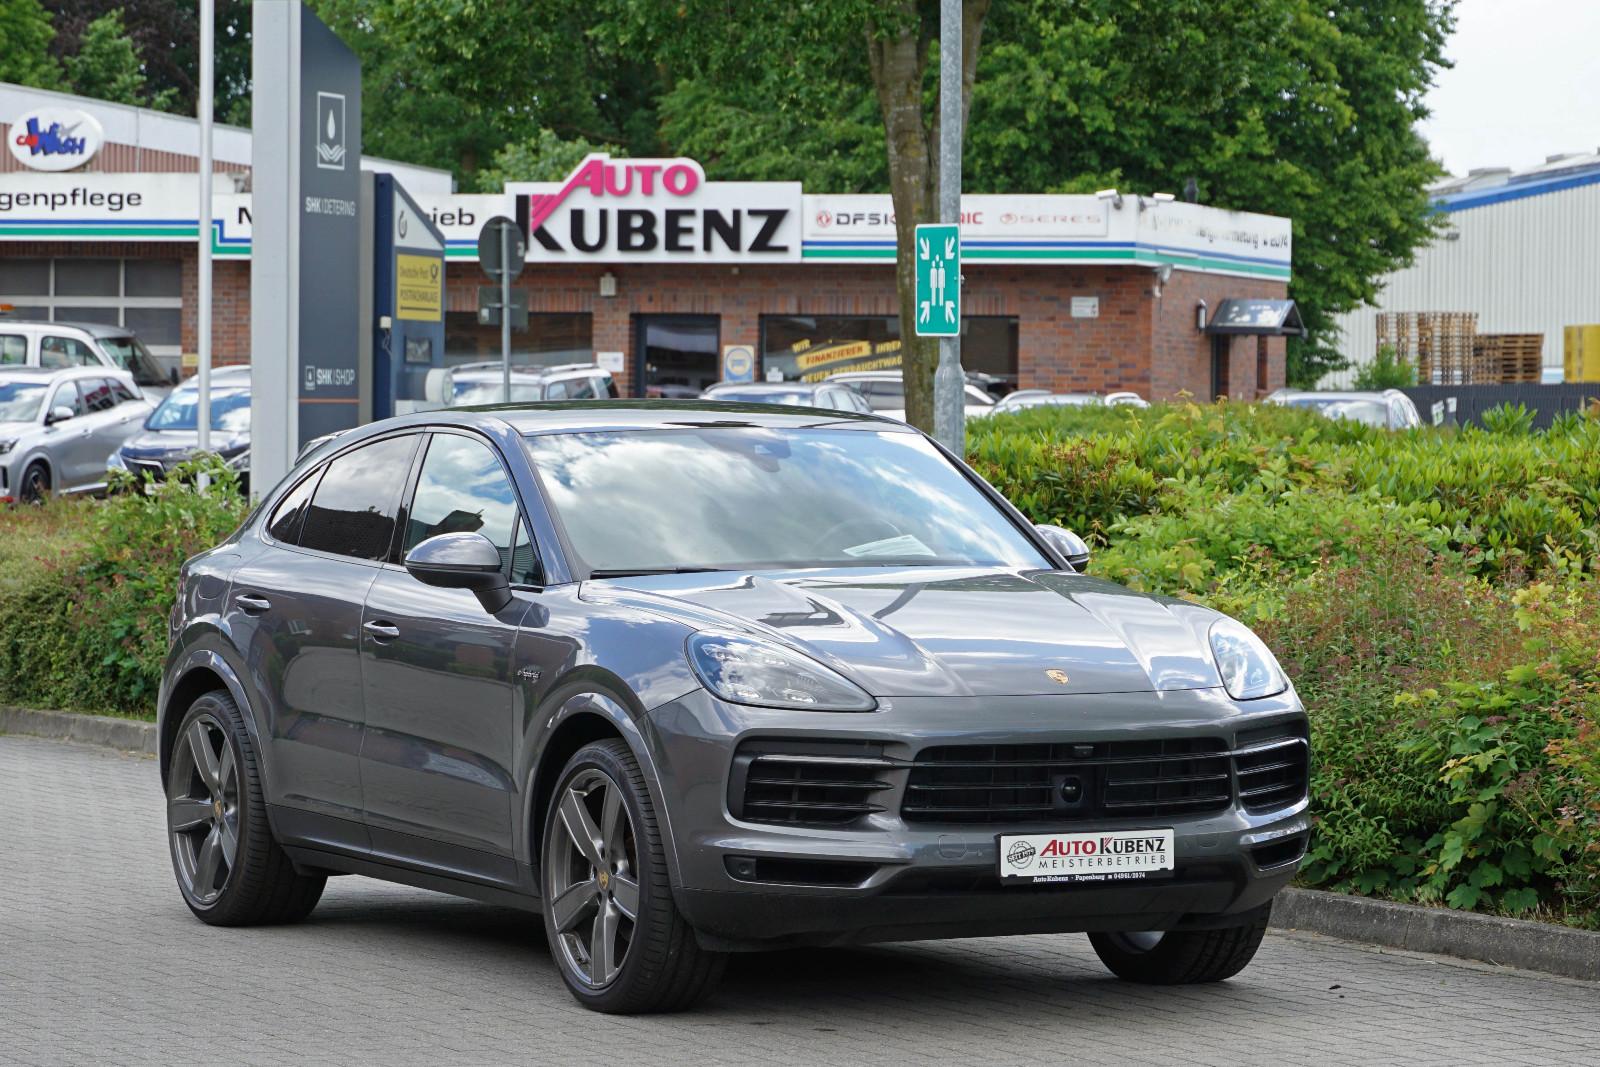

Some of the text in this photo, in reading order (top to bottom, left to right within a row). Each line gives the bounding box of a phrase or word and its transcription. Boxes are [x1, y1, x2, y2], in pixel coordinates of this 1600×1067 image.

[558, 160, 699, 196] AUTO
[516, 194, 789, 253] KUBENZ
[1040, 837, 1165, 857] AUTO KUBENZ
[1038, 855, 1166, 869] MEISTERBETRIEB
